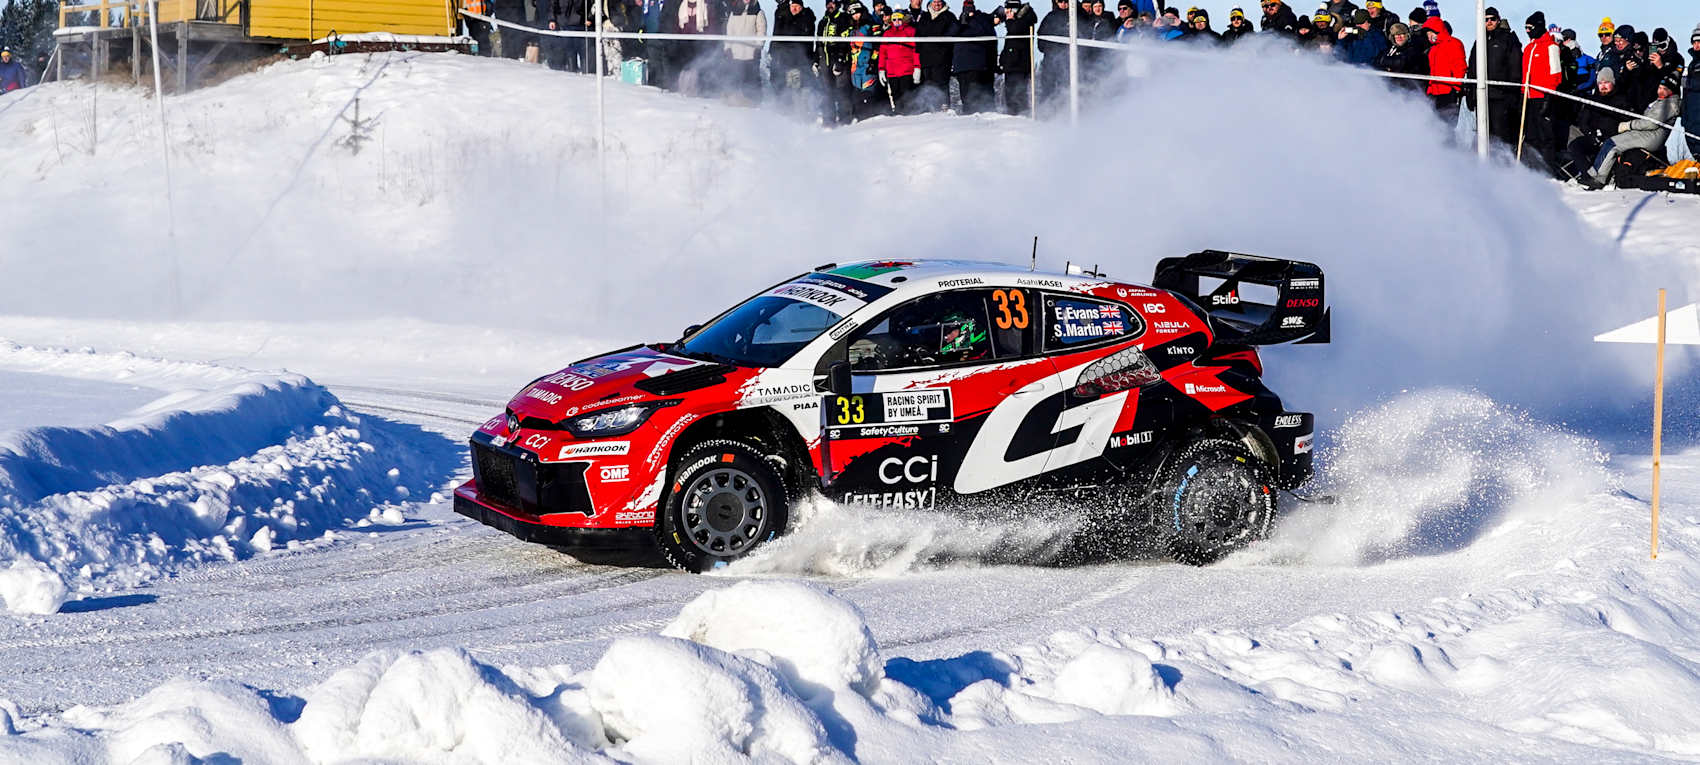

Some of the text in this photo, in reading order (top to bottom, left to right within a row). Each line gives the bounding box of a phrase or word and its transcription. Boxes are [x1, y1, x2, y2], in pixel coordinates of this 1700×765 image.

[938, 277, 985, 288] PROTERIAL
[1212, 291, 1240, 305] Stilo
[1286, 298, 1319, 308] DENSO
[992, 289, 1029, 330] 33
[544, 372, 595, 391] DENSO
[757, 384, 811, 397] TAMADIC
[1196, 384, 1226, 393] Microsoft
[793, 402, 819, 410] PIAA
[887, 394, 941, 406] RACING SPIRIT
[836, 395, 865, 425] 33
[888, 408, 898, 418] BY
[1274, 414, 1302, 427] ENDLESS
[860, 425, 919, 436] SafetyCulture
[1110, 432, 1140, 448] Mobil
[600, 468, 630, 480] OMP
